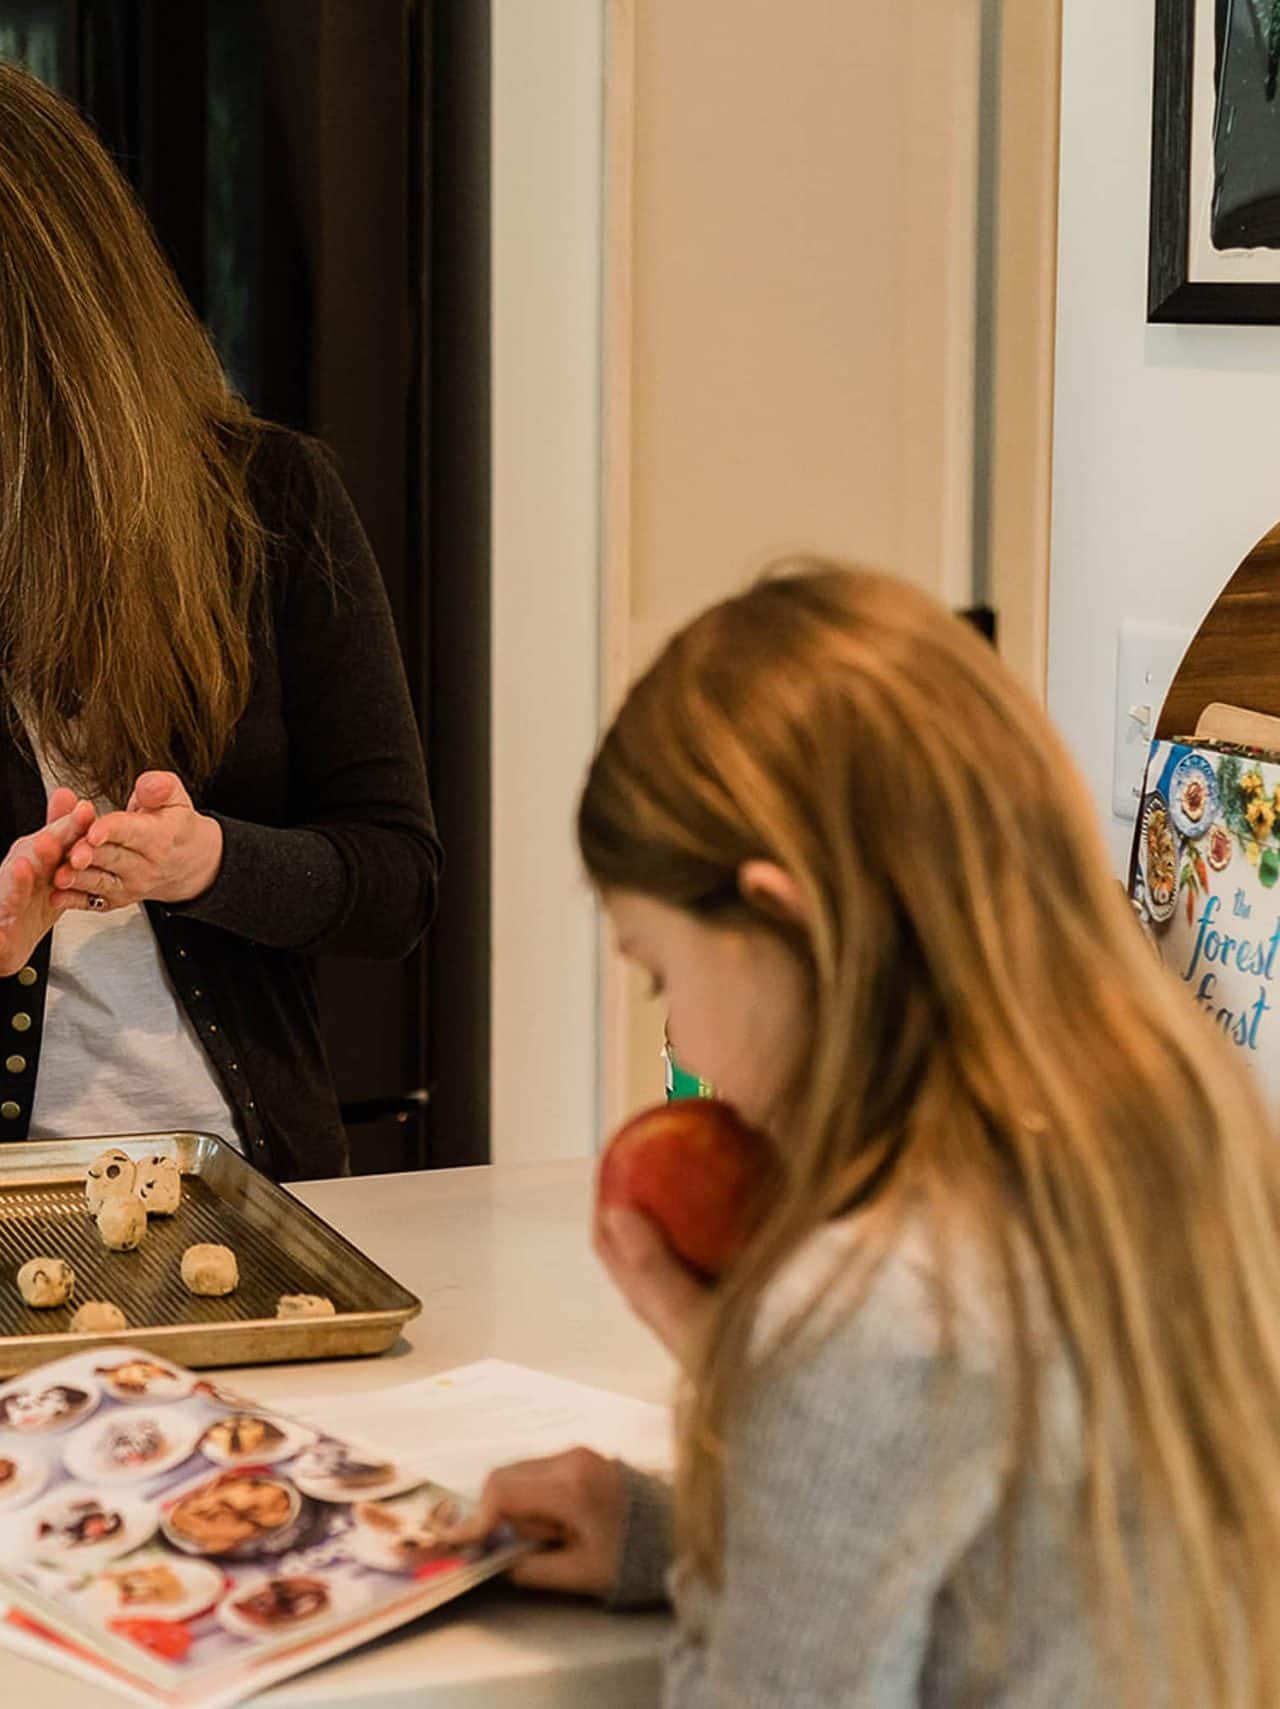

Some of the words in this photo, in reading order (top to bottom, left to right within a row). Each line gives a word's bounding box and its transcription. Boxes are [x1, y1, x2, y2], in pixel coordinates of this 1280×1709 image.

[1181, 895, 1280, 981] forest
[1232, 888, 1252, 919] the
[1196, 972, 1270, 1050] ast
